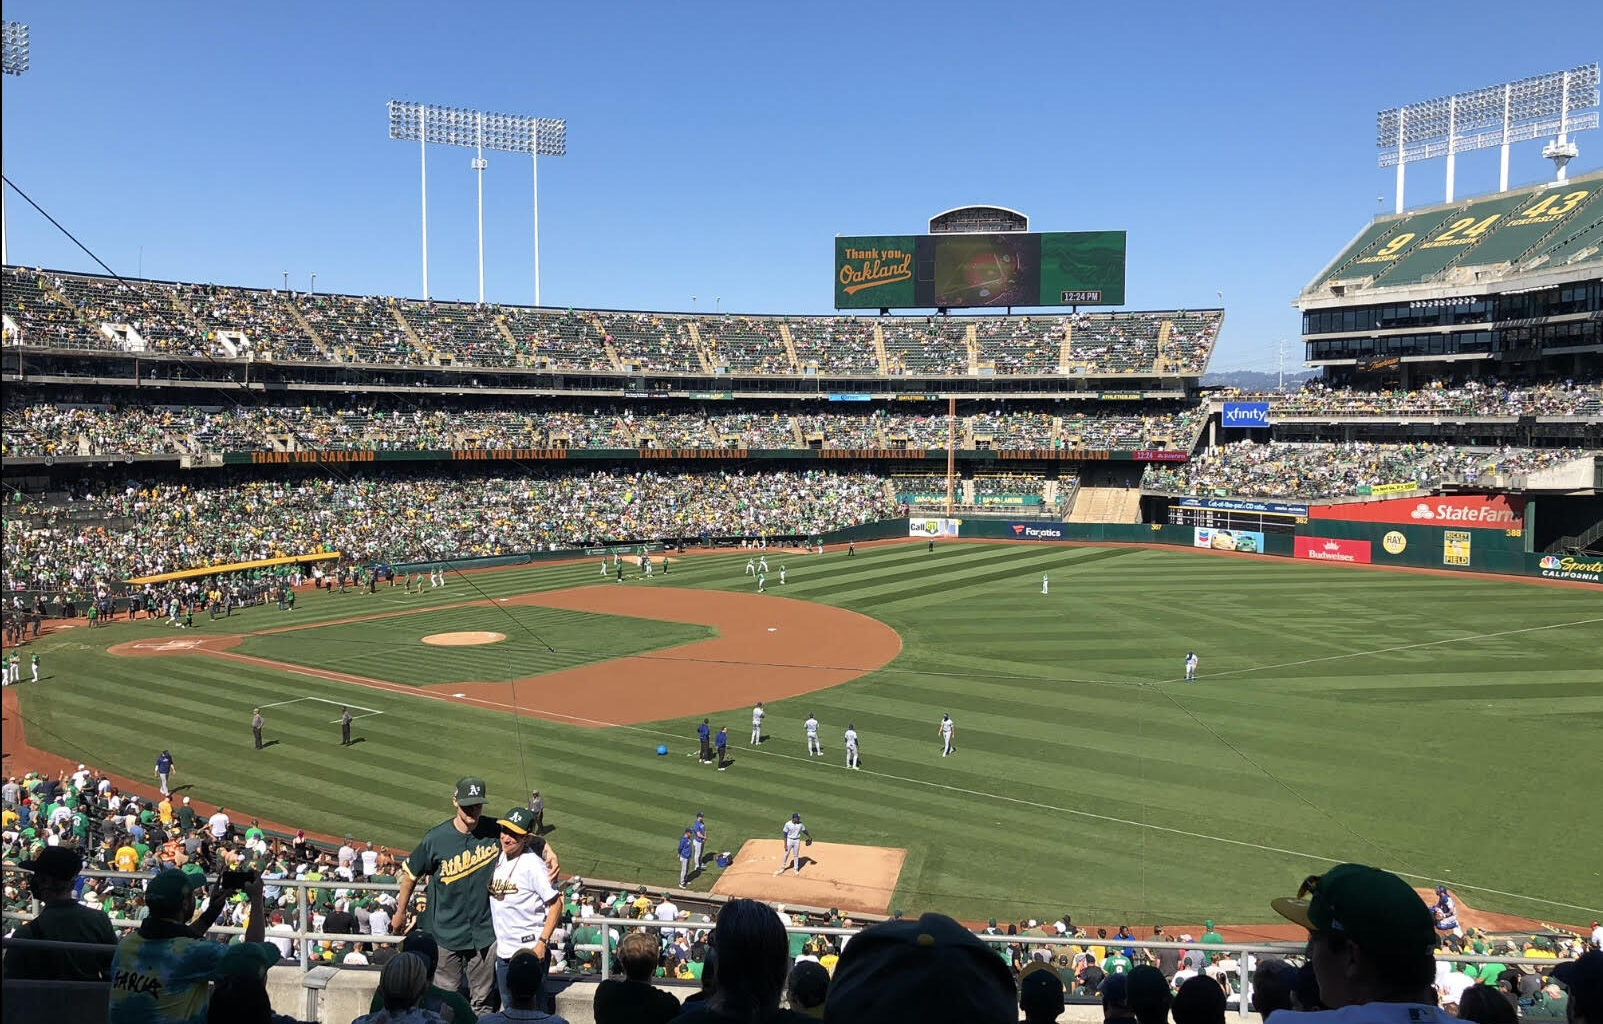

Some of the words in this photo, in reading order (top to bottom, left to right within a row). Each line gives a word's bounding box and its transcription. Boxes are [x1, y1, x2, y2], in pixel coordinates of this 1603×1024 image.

[1521, 191, 1589, 217] 43
[1434, 214, 1501, 242] 24
[1377, 232, 1415, 256] 9
[845, 248, 878, 259] Thank
[881, 249, 904, 261] you,
[840, 253, 911, 285] Oakland
[1064, 292, 1085, 301] 12:24
[1087, 292, 1098, 301] PM
[1226, 407, 1265, 421] xfinity
[251, 451, 289, 463] THANK
[294, 451, 316, 463] YOU
[321, 451, 374, 462] OAKLAND
[452, 450, 487, 460] THANK
[491, 450, 512, 460] YOU
[516, 450, 566, 460] OAKLAND
[638, 450, 672, 459] THANK
[676, 450, 696, 459] YOU
[701, 450, 748, 459] OAKLAND
[817, 450, 850, 459] THANK
[855, 450, 874, 459] YOU
[878, 450, 925, 459] OAKLAND
[997, 450, 1031, 460] THANK
[1035, 450, 1055, 460] YOU
[1059, 450, 1109, 460] OAKLAND
[1436, 504, 1478, 521] State
[911, 523, 925, 531] Call
[1506, 529, 1521, 537] 388
[1386, 536, 1402, 544] RAY
[1309, 549, 1354, 562] Budweiser
[1445, 556, 1468, 564] FIELD
[1561, 557, 1603, 574] Sports
[1542, 570, 1599, 581] CALIFORNIA
[440, 843, 499, 877] Athletics
